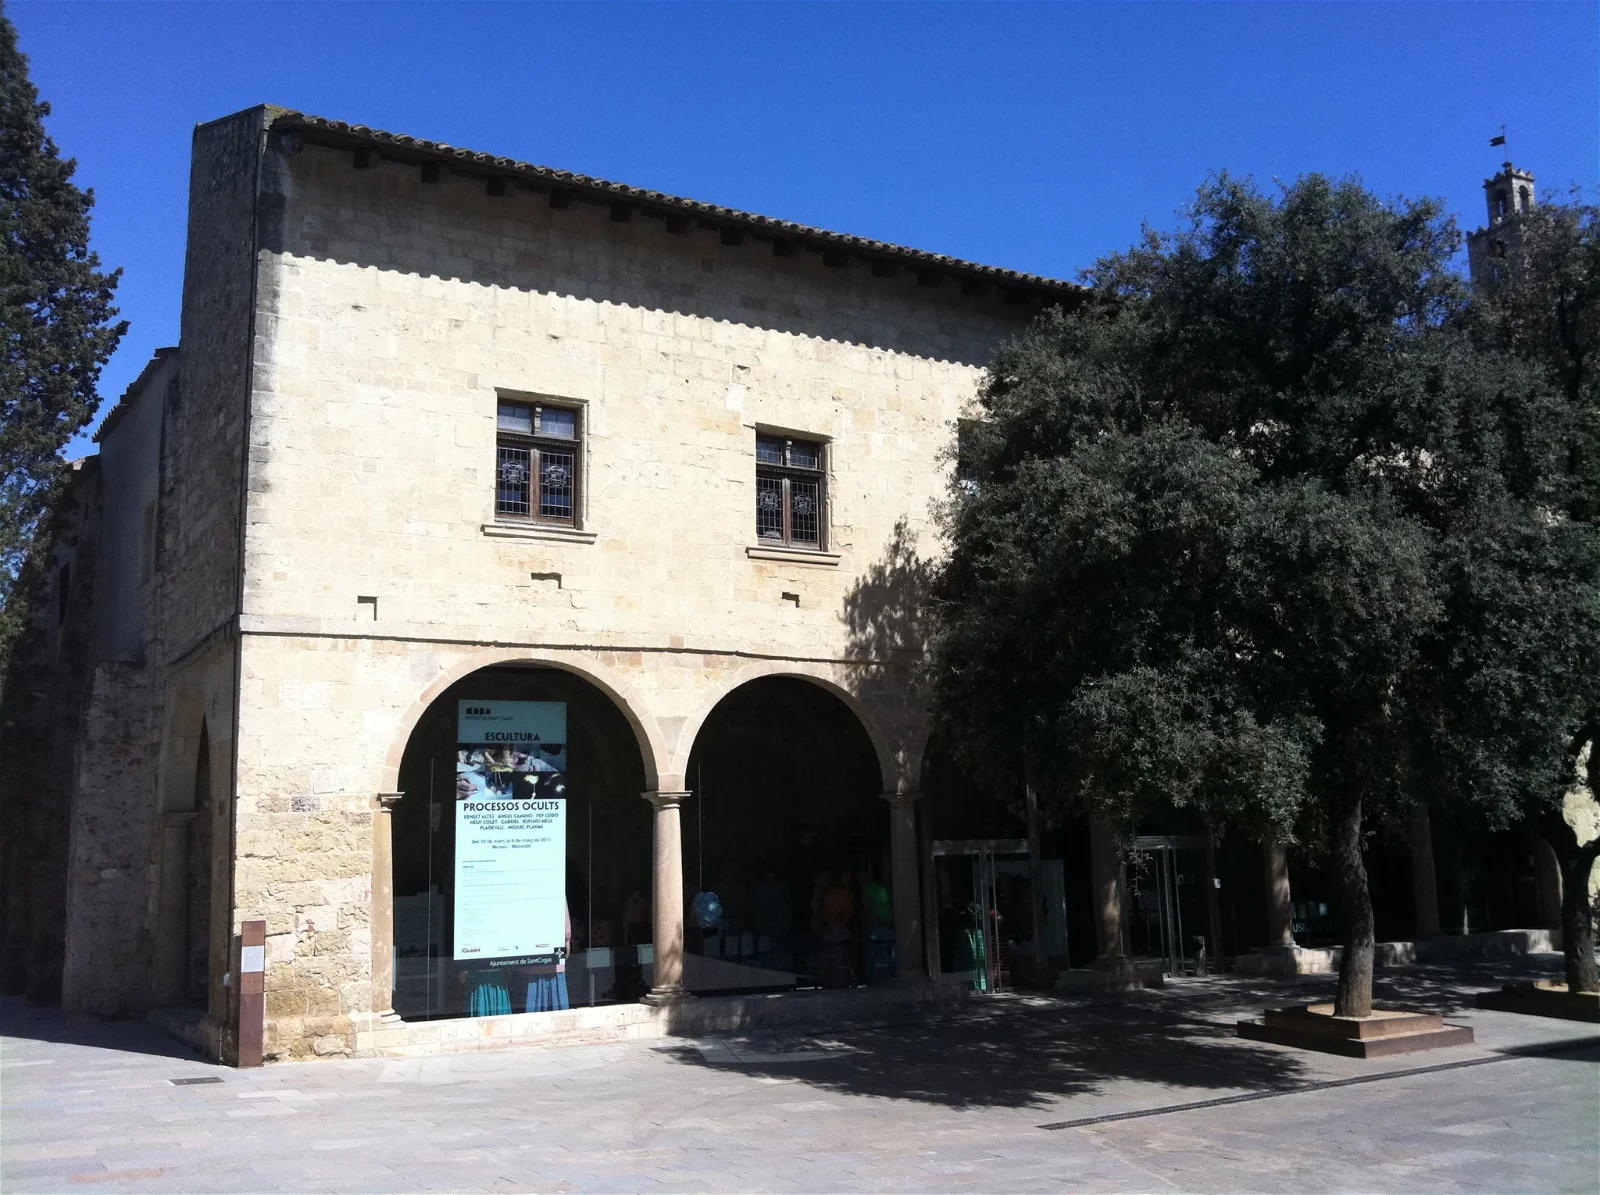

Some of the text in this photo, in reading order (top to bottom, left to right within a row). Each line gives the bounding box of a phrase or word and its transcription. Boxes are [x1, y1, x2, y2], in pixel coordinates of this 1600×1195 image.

[485, 732, 540, 742] ESCULTURA
[463, 801, 559, 812] PROCESSOS OCULTS
[489, 959, 519, 967] Ajuntament
